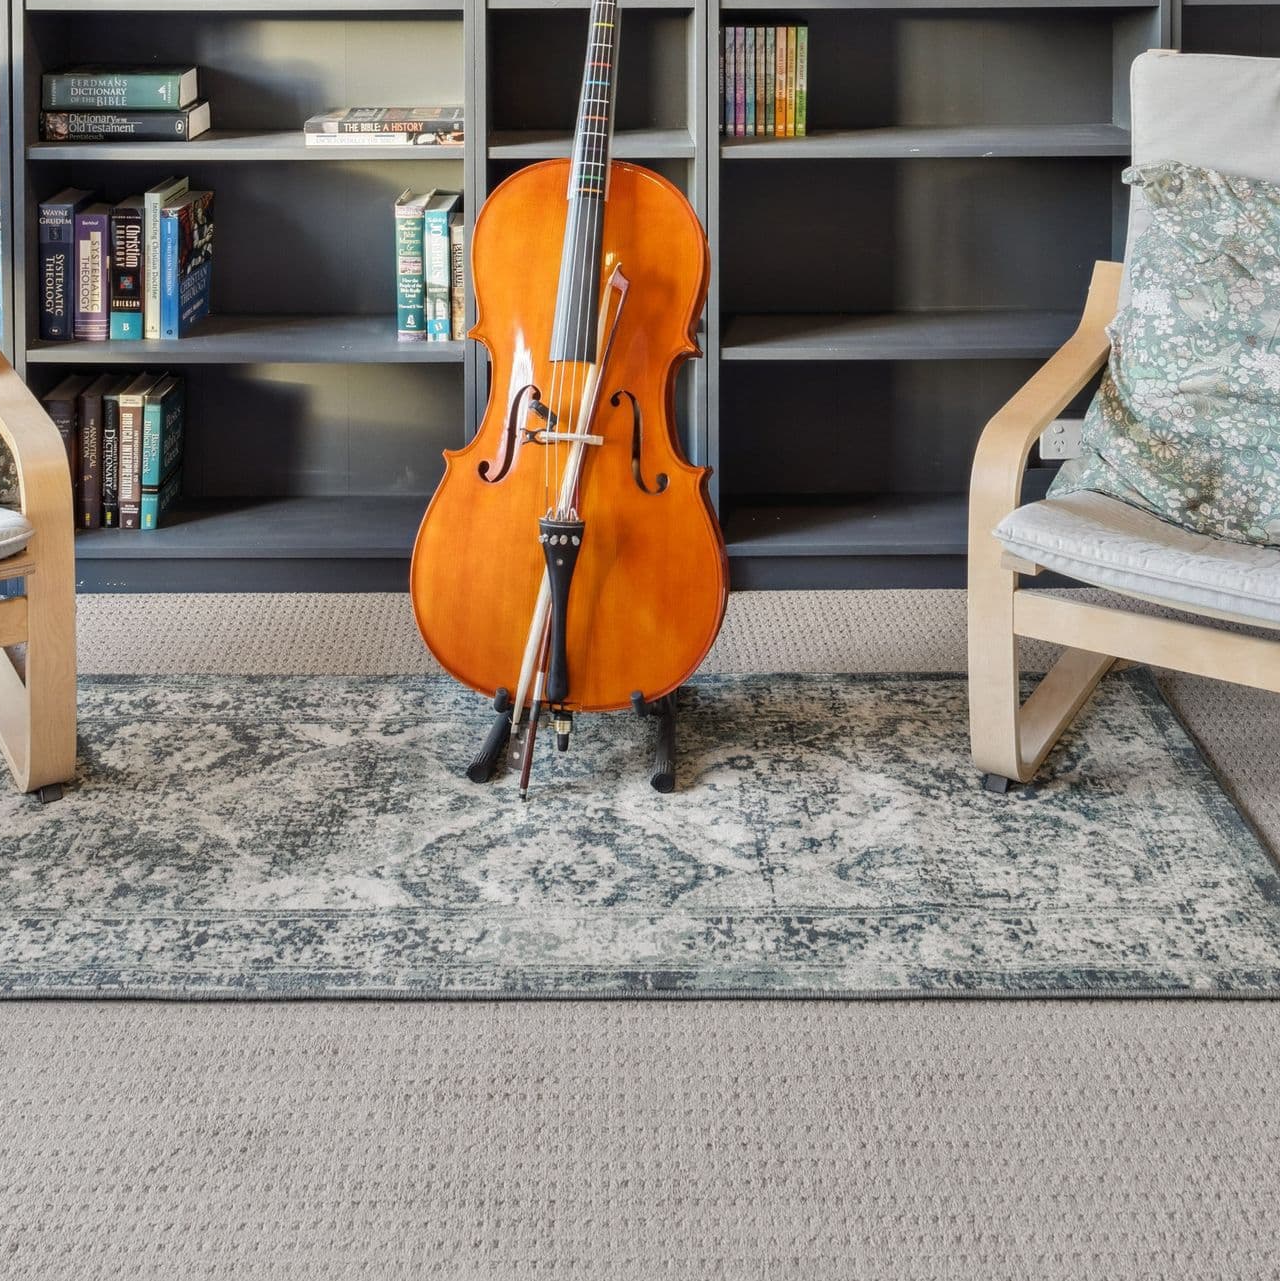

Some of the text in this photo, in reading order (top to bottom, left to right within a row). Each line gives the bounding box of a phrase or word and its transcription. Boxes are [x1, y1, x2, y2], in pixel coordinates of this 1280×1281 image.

[70, 88, 127, 96] DICTIONARY
[71, 79, 128, 87] EERDMANS
[96, 96, 128, 106] BIBLE
[69, 114, 117, 123] Dictionary
[69, 123, 135, 133] Old Testament
[344, 123, 423, 132] THE BIBLE: A HISTORY
[116, 224, 125, 268] THEOLOGY
[126, 224, 141, 268] Christian
[431, 223, 443, 278] JOSEPHUS
[46, 256, 55, 314] THEOLOGY
[55, 254, 65, 316] SYSTEMATIC
[81, 256, 90, 311] THEOLOGY
[91, 240, 100, 311] SYSTEMATIC
[112, 300, 140, 308] ERICKSON
[122, 413, 133, 443] BIBLICAL
[143, 420, 152, 474] Biblical Greek
[151, 433, 159, 457] Basics
[104, 429, 116, 488] DICTIONARY
[122, 444, 133, 499] INTERPRETATION
